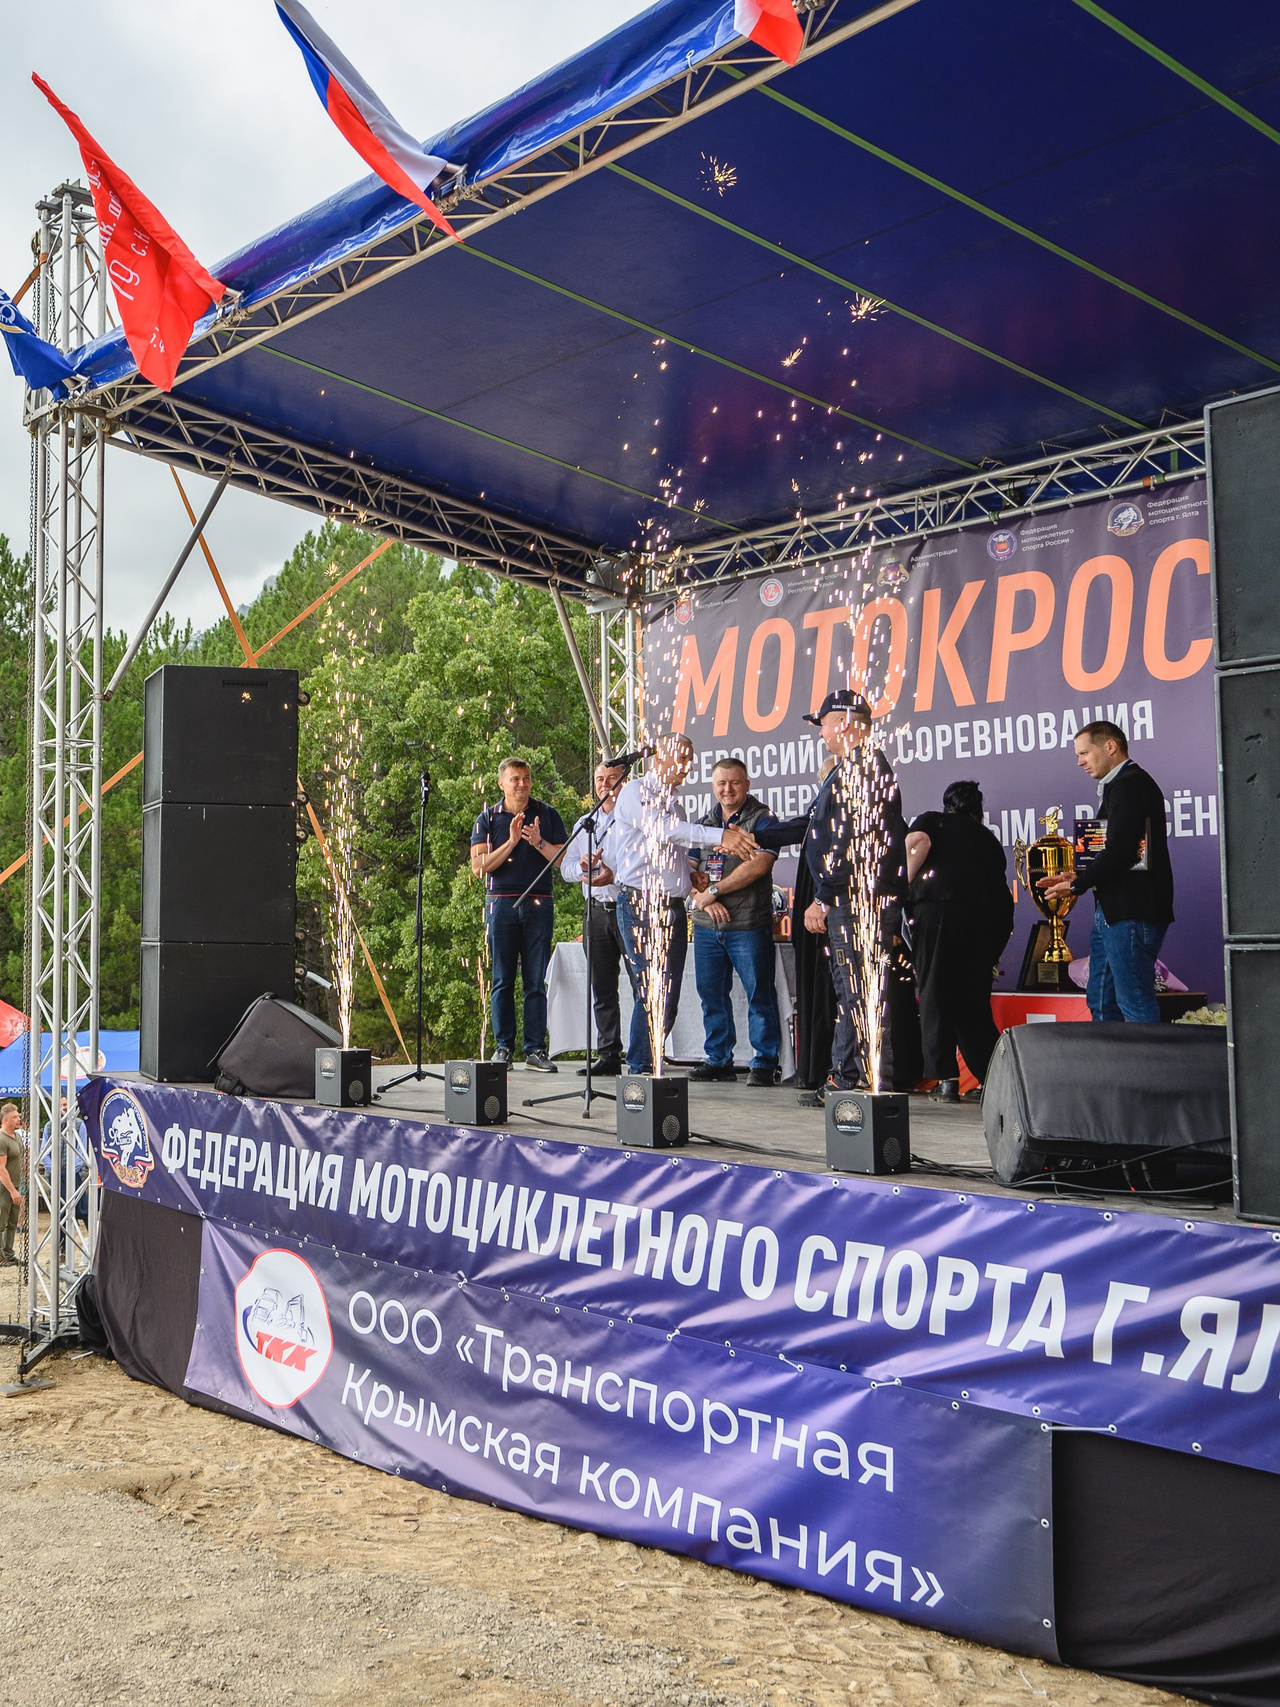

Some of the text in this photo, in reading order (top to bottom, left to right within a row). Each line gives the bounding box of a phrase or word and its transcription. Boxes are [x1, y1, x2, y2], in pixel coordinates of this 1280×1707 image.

[1147, 494, 1189, 509] Федерация
[1148, 499, 1208, 517] мотоциклетного
[1149, 515, 1175, 526] спорта
[1182, 510, 1200, 519] Ялта
[1019, 523, 1058, 536] Федерация
[1021, 528, 1075, 544] мотоциклетного
[1022, 537, 1070, 552] спорта России
[910, 548, 958, 562] Администрация
[670, 538, 1213, 737] МОТОКРОС
[162, 1122, 342, 1212] ФЕДЕРАЦИЯ
[350, 1157, 779, 1301] МОТОЦИКЛЕТНОГО
[792, 1234, 1067, 1360] СПОРТА
[348, 1290, 896, 1493] ООО «Транспортная
[340, 1361, 946, 1609] Крымская компания»
